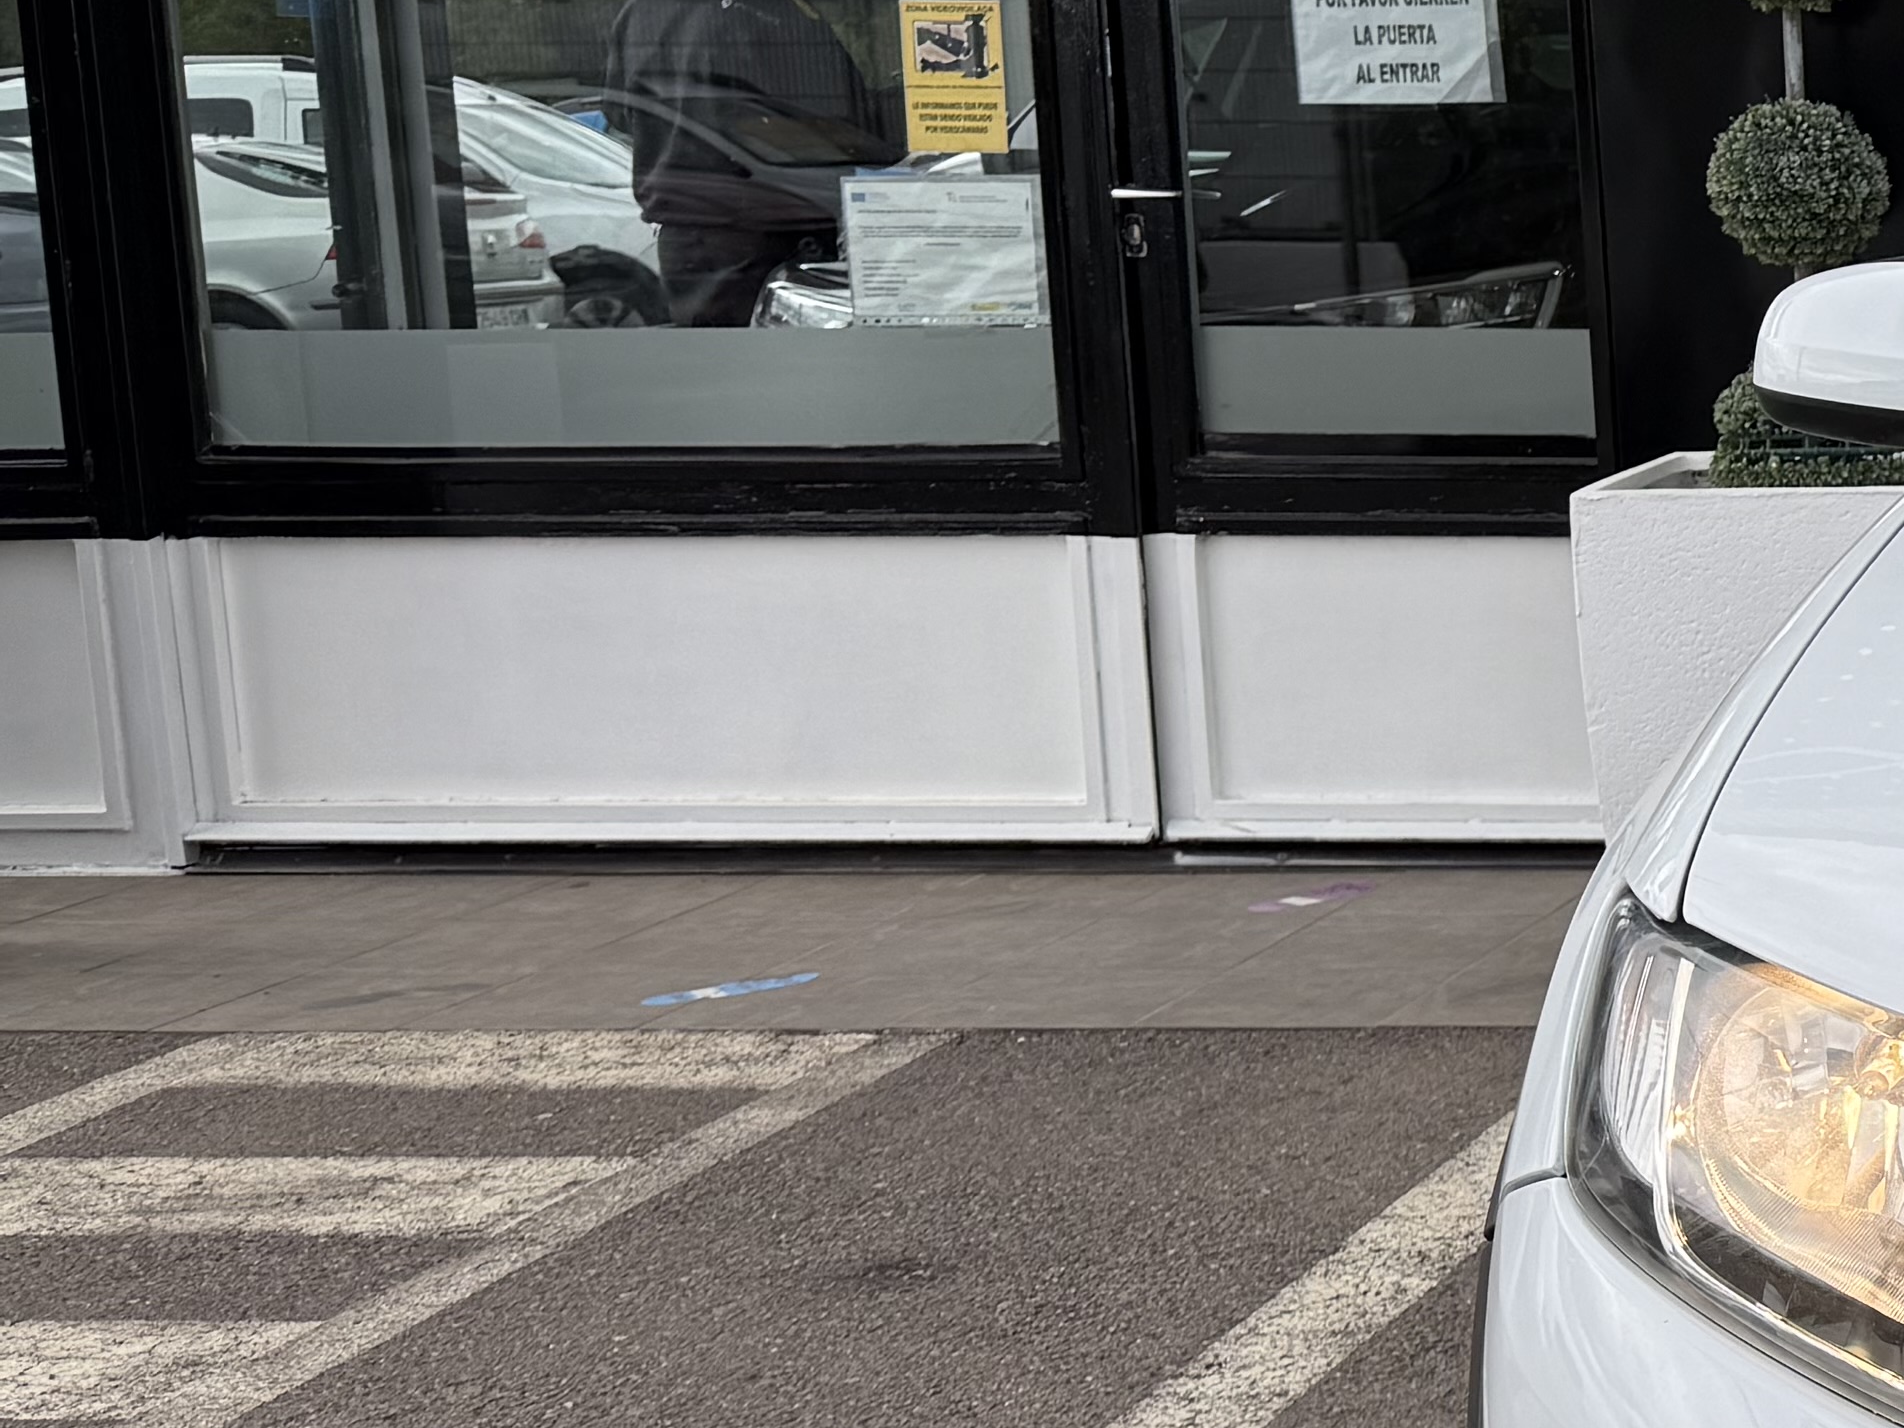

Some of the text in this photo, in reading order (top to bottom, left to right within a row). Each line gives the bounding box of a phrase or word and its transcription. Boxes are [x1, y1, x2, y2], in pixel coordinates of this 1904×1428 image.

[1353, 24, 1437, 46] LA PUERTA
[1356, 63, 1441, 84] AL ENTRAR
